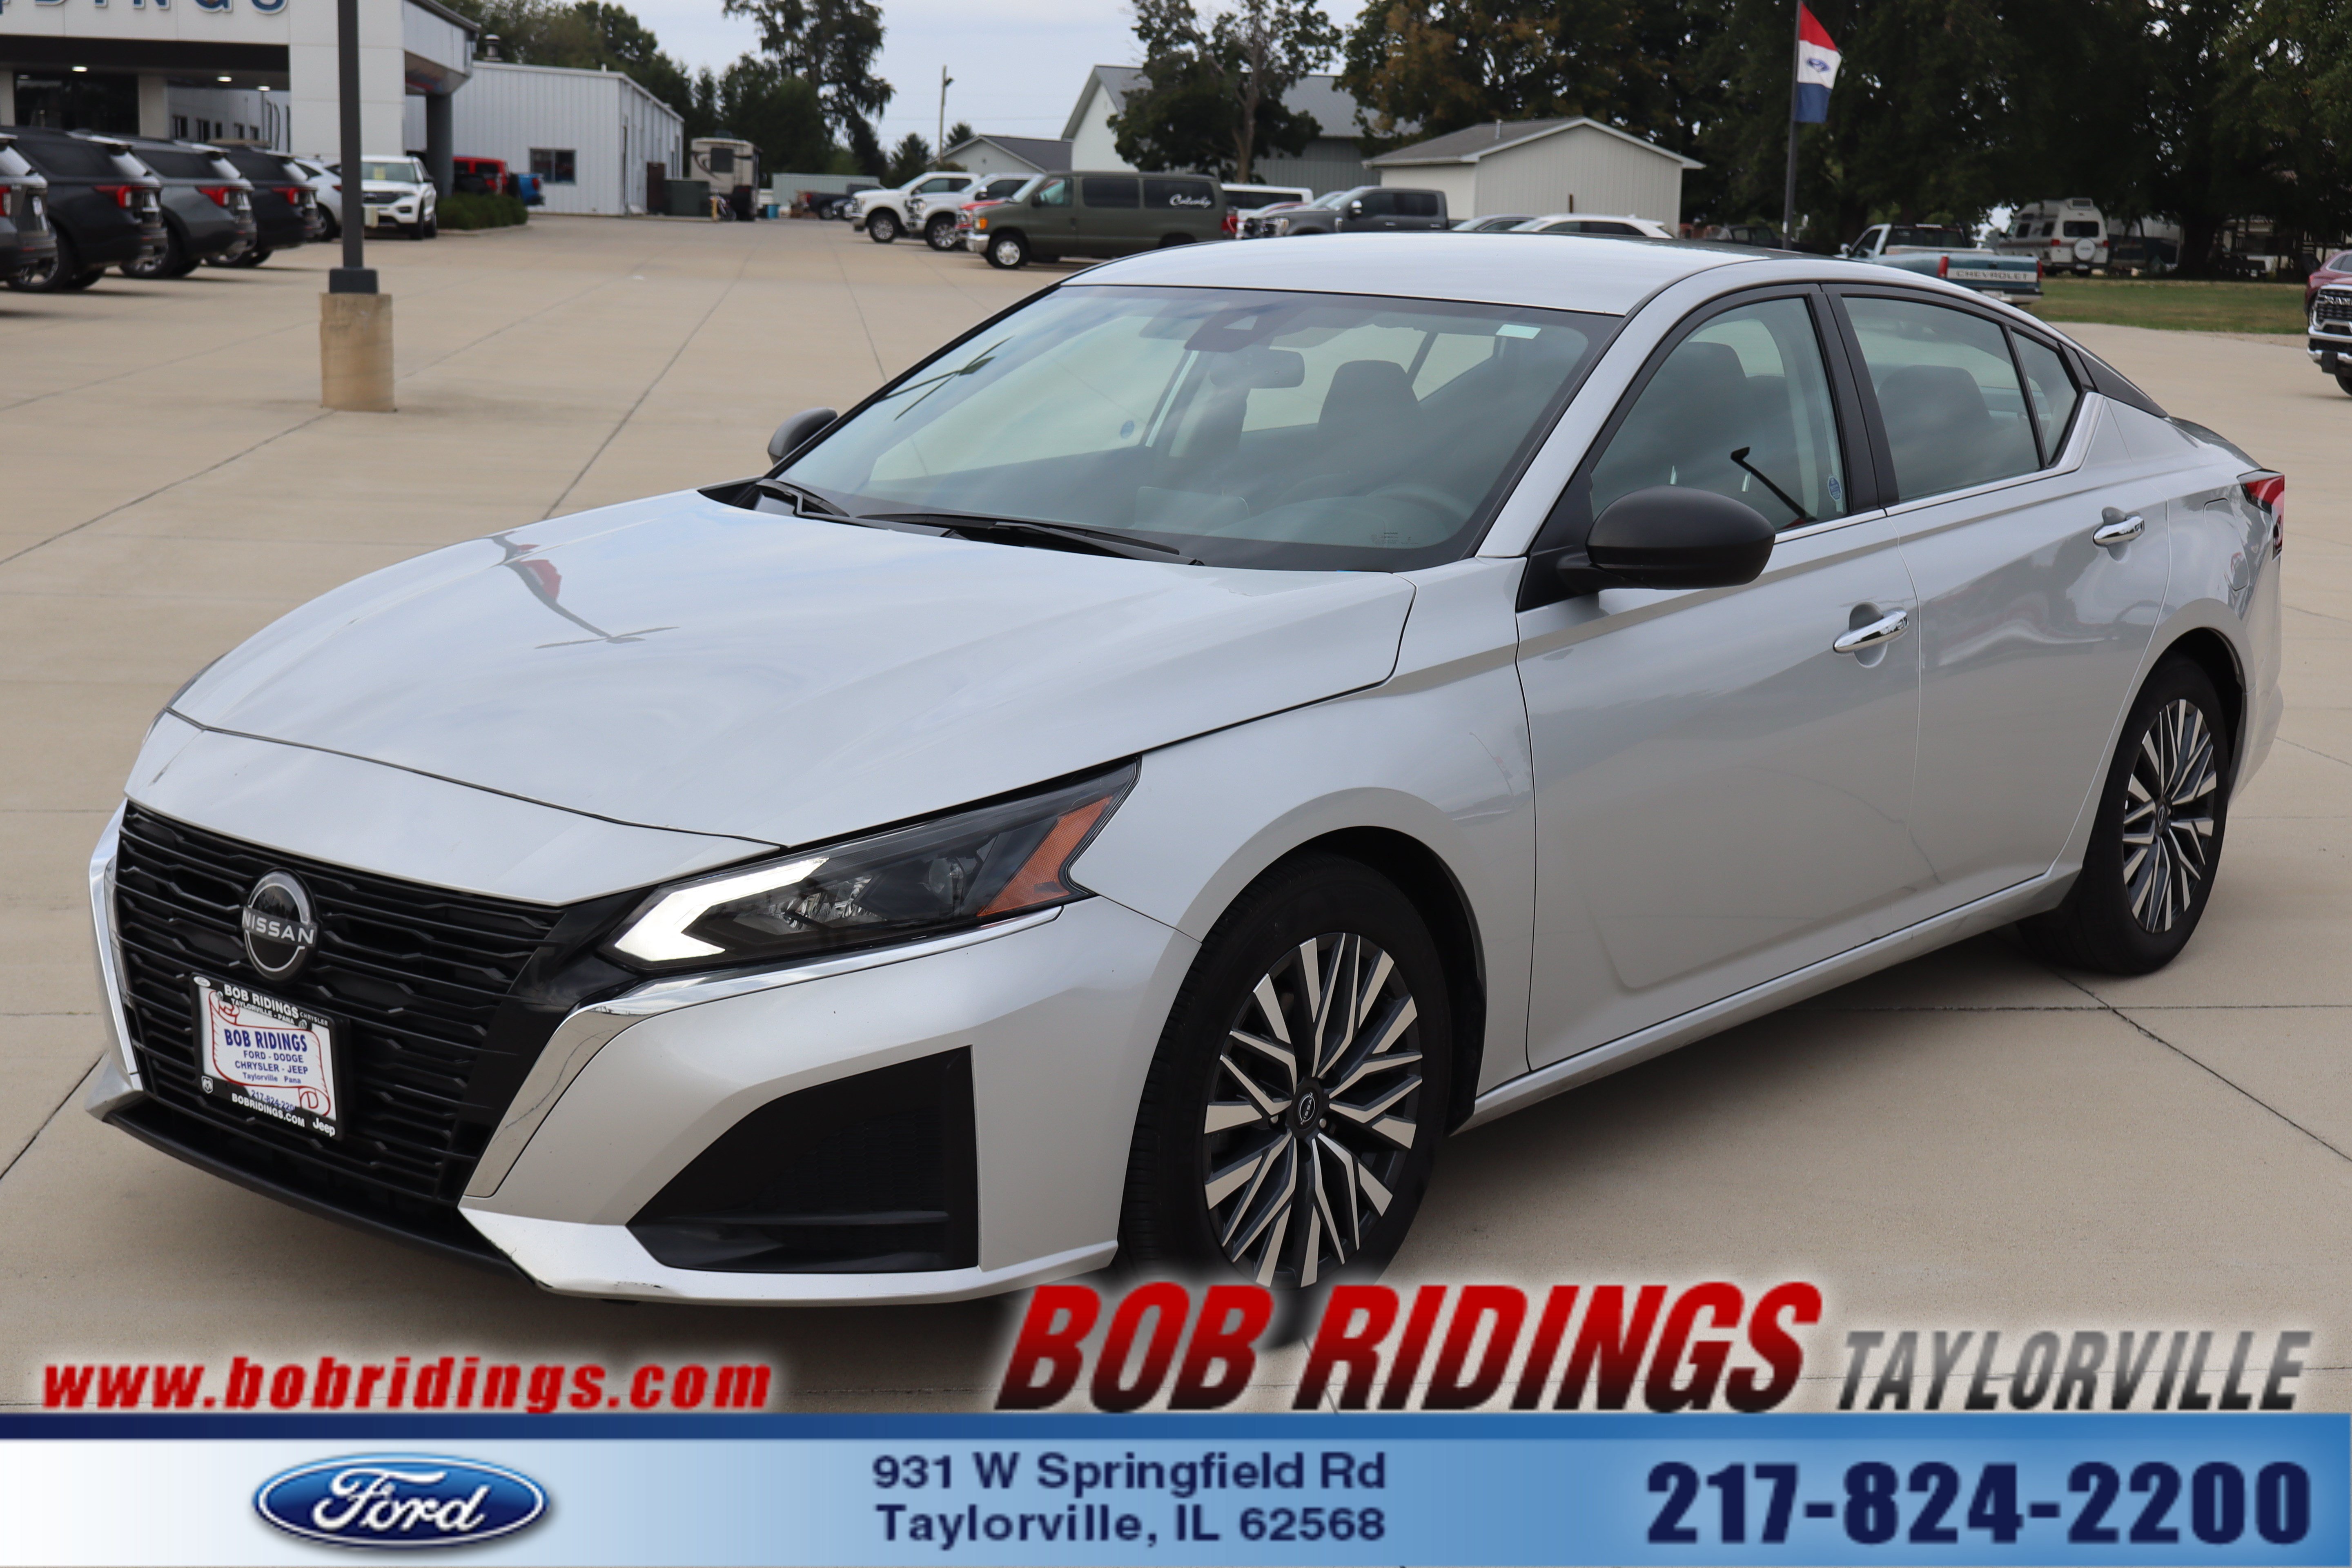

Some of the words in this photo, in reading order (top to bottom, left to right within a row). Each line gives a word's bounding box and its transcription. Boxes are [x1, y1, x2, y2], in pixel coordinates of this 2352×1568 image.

[1956, 270, 2027, 281] CHEVROLET
[242, 909, 314, 944] NISSAN
[224, 984, 249, 1002] BOB
[252, 993, 299, 1019] RIDINGS
[300, 1011, 328, 1027] CHRYSLER
[231, 998, 272, 1018] TAYLORVILLE
[278, 1013, 295, 1025] PANA
[224, 1029, 251, 1047] BOB
[254, 1031, 307, 1052] RIDINGS
[235, 1060, 280, 1072] CHRYSLER
[287, 1065, 308, 1074] JEEP
[243, 1050, 266, 1060] FORD
[274, 1052, 304, 1063] DODGE
[243, 1072, 278, 1081] Taylorville
[284, 1076, 301, 1084] Pana
[252, 1089, 296, 1111] 217-824-220
[232, 1093, 305, 1127] BOBRIDINGS.COM
[312, 1117, 336, 1137] Jeep
